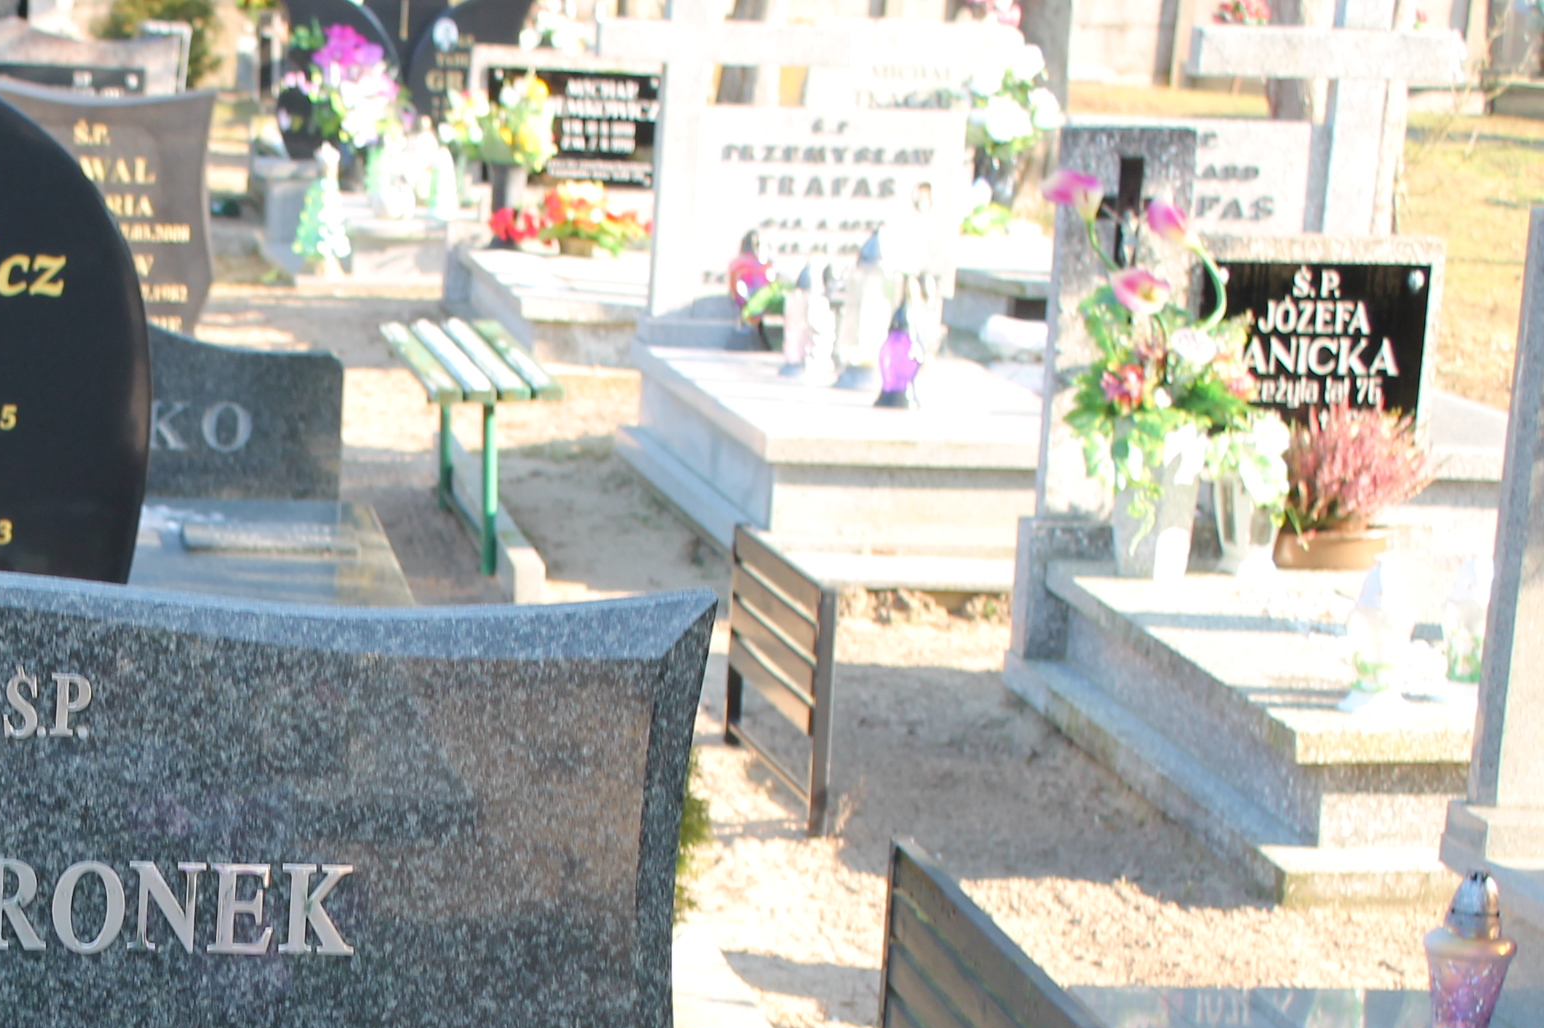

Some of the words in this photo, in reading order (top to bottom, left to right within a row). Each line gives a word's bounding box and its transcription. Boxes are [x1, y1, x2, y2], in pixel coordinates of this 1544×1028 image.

[79, 155, 157, 184] WAL
[756, 175, 896, 199] TRAFAS
[1257, 295, 1372, 336] JÓZEFA
[1243, 335, 1400, 377] ANICKA
[149, 400, 253, 453] KO
